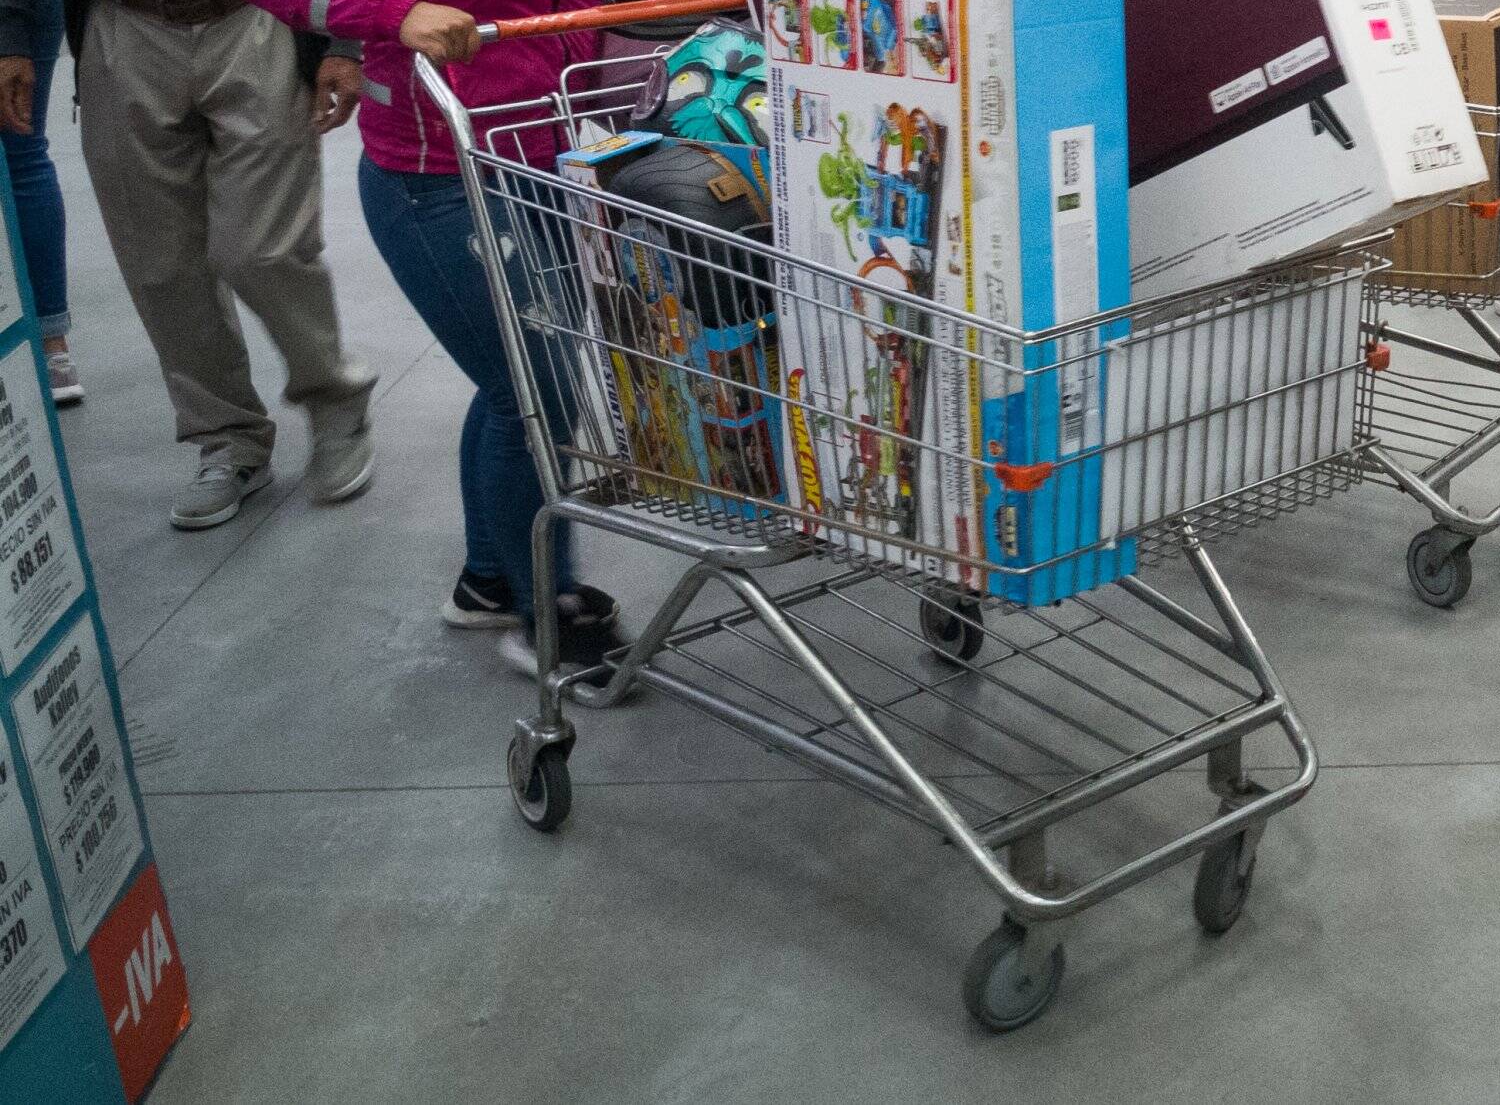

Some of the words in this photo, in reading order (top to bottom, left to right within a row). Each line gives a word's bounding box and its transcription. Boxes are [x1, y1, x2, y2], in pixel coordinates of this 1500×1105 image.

[26, 508, 42, 537] SIN
[41, 495, 57, 519] IVA
[17, 532, 54, 585] 88.151
[11, 879, 33, 910] IVA
